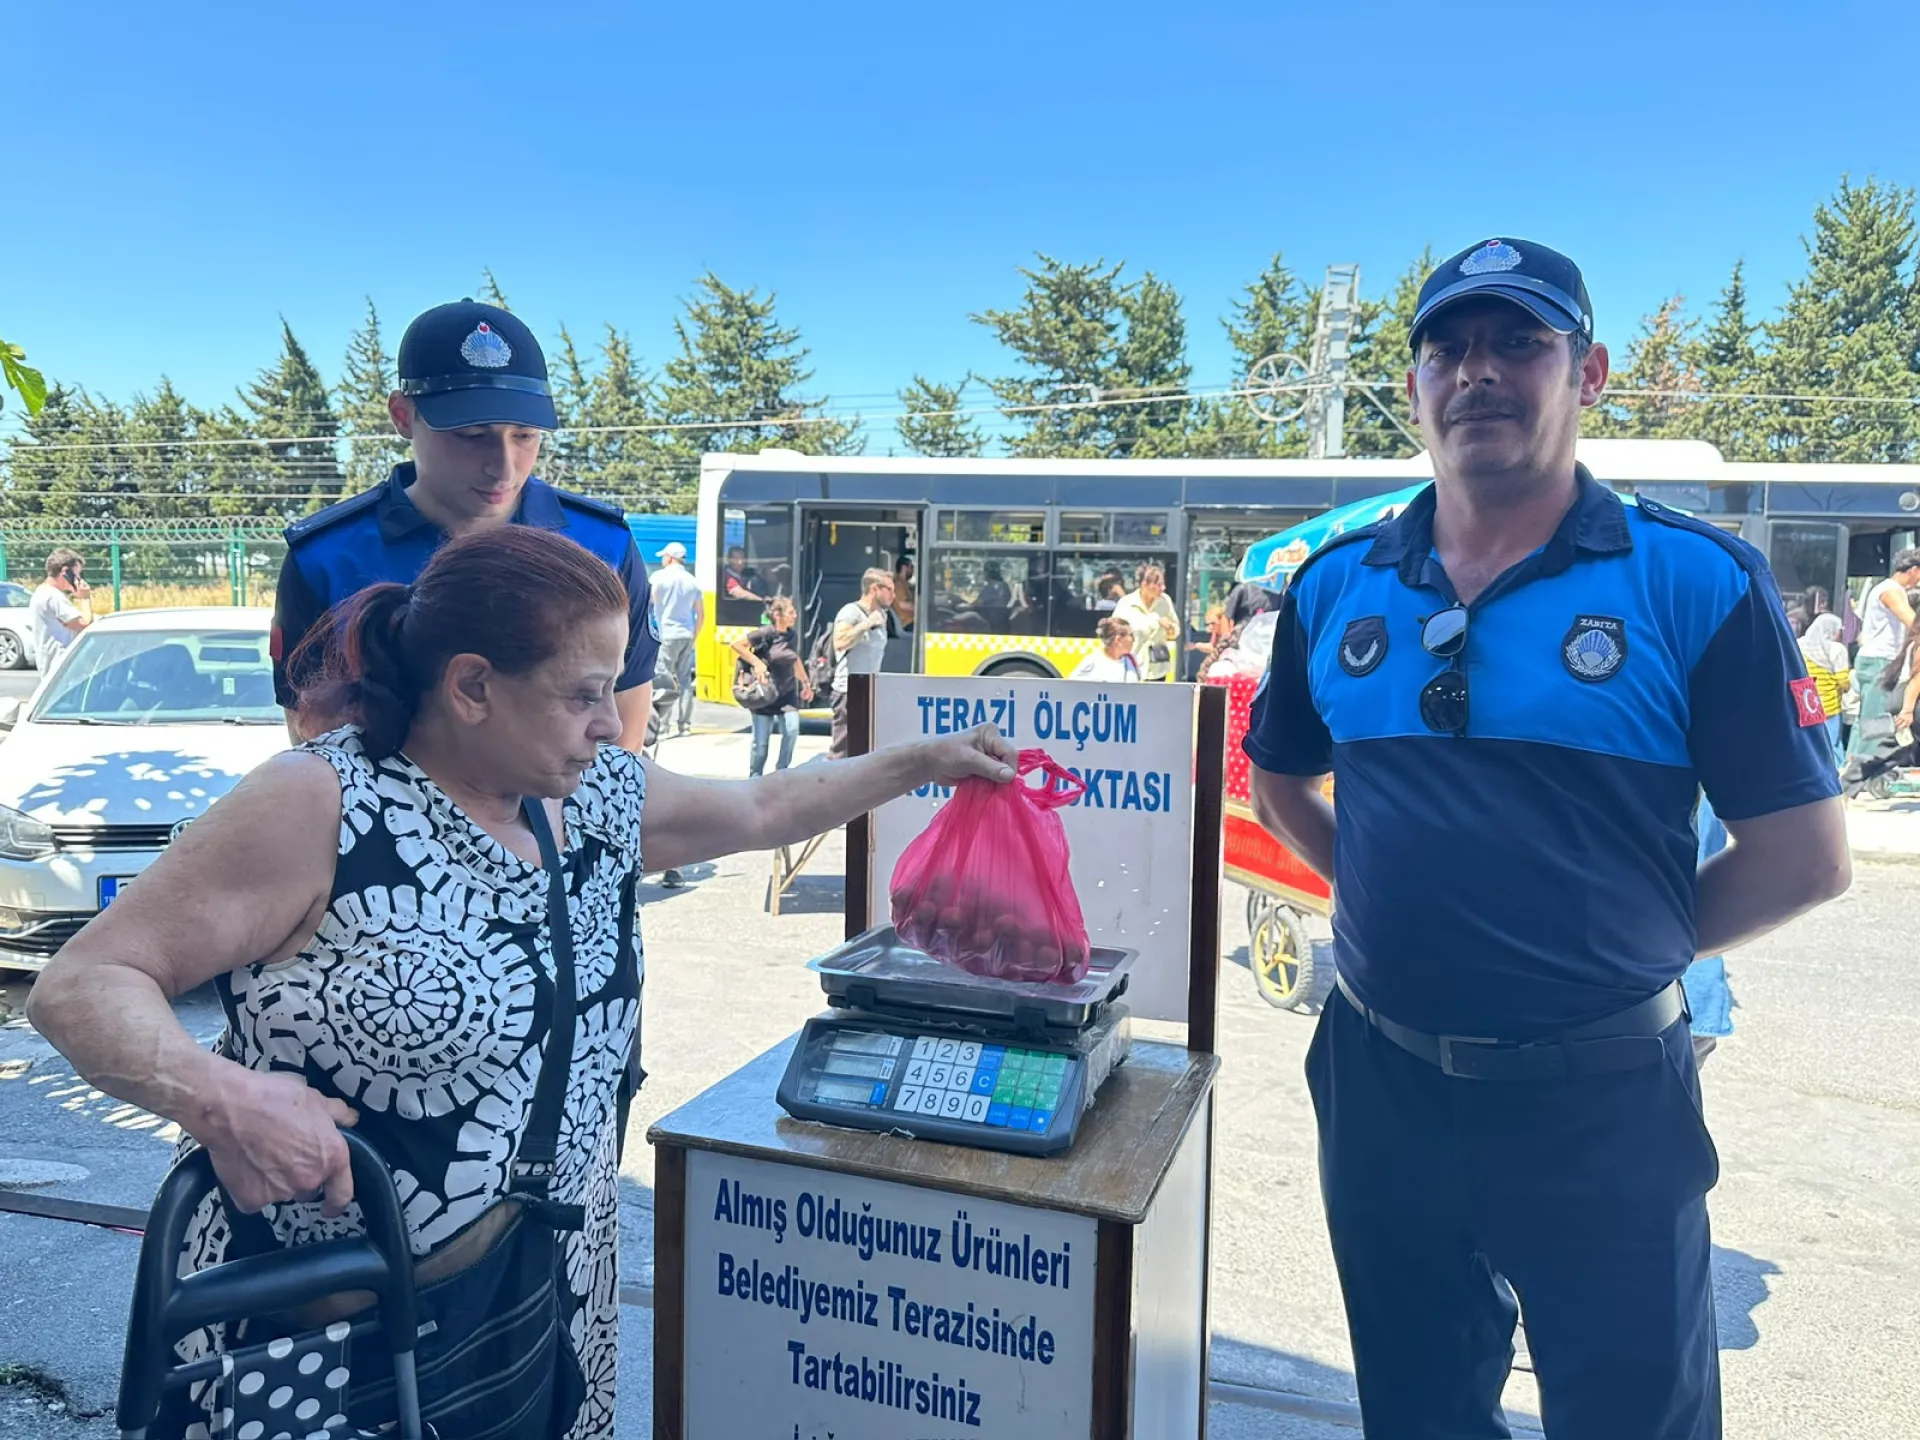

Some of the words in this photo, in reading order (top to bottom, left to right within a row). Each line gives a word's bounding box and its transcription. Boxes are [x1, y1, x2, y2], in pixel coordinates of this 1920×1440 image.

[1580, 618, 1618, 630] ZABITA
[917, 689, 1015, 738] TERAZİ
[1033, 692, 1137, 752] ÖLÇÜM
[921, 1042, 930, 1056] 1
[941, 1044, 954, 1058] 2
[963, 1046, 975, 1060] 3
[911, 1066, 922, 1080] 4
[933, 1069, 945, 1083] 5
[955, 1071, 968, 1085] 6
[979, 1076, 990, 1087] C
[904, 1090, 915, 1106] 7
[924, 1094, 937, 1109] 8
[947, 1097, 960, 1112] 9
[971, 1100, 982, 1116] 0
[714, 1177, 787, 1244] Almış
[796, 1191, 942, 1263] Olduğunuz
[951, 1210, 1070, 1290] Ürünleri
[718, 1252, 879, 1328] Belediyemiz
[887, 1285, 1055, 1365] Terazisinde
[787, 1339, 981, 1427] Tartabilirsiniz
